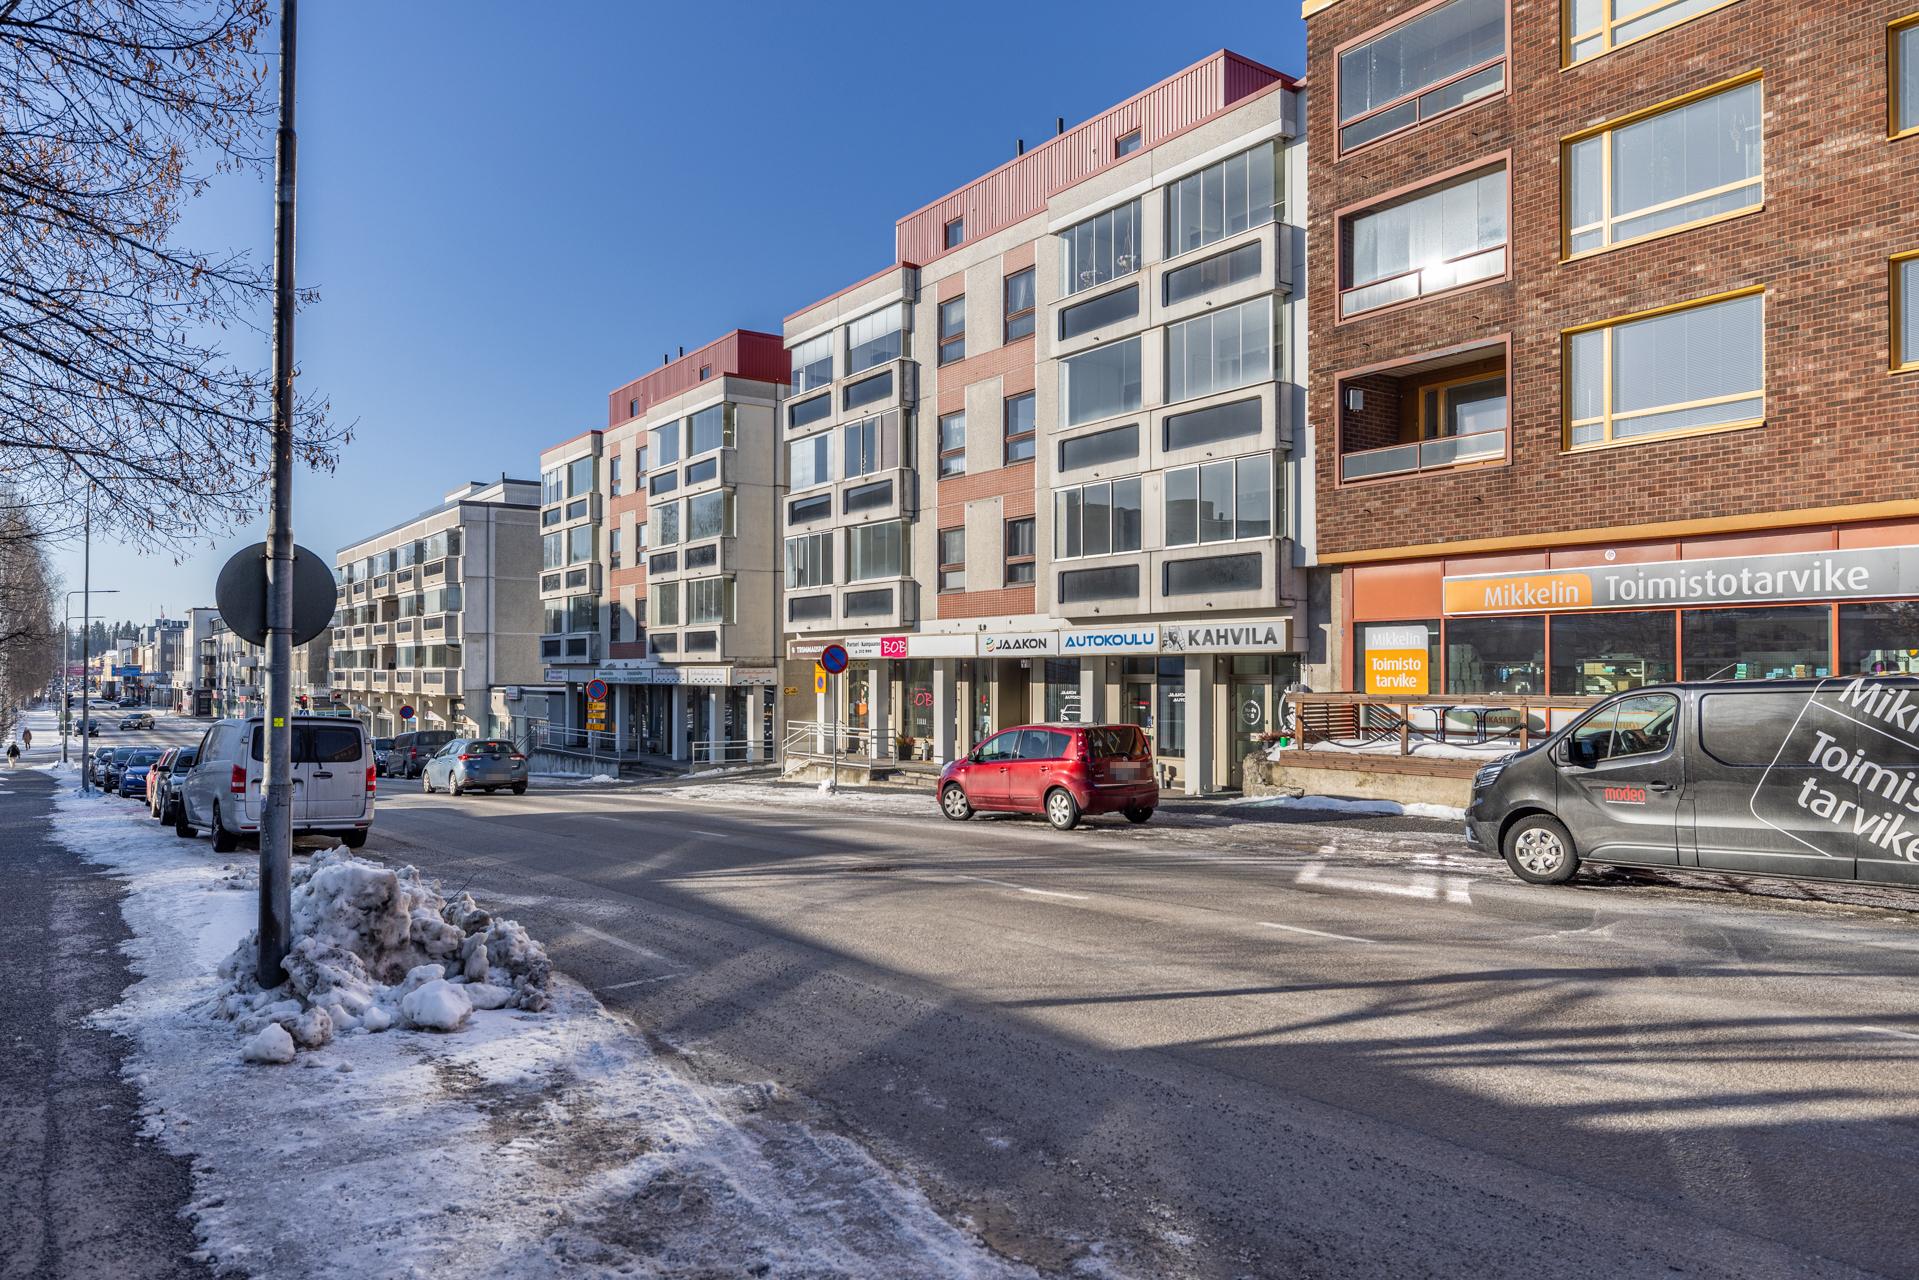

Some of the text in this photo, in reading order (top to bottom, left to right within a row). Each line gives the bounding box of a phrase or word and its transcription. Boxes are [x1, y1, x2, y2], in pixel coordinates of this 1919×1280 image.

[1484, 559, 1870, 608] Mikkelin Toimistotarvike
[995, 637, 1047, 650] JAAKON
[1065, 632, 1154, 648] AUTOKOULU
[1188, 626, 1278, 647] KAHVILA
[1371, 631, 1421, 646] Mikkelin
[882, 640, 906, 654] BOB
[1371, 656, 1421, 671] Toimisto
[1375, 672, 1417, 688] tarvike
[1604, 784, 1646, 801] modeo
